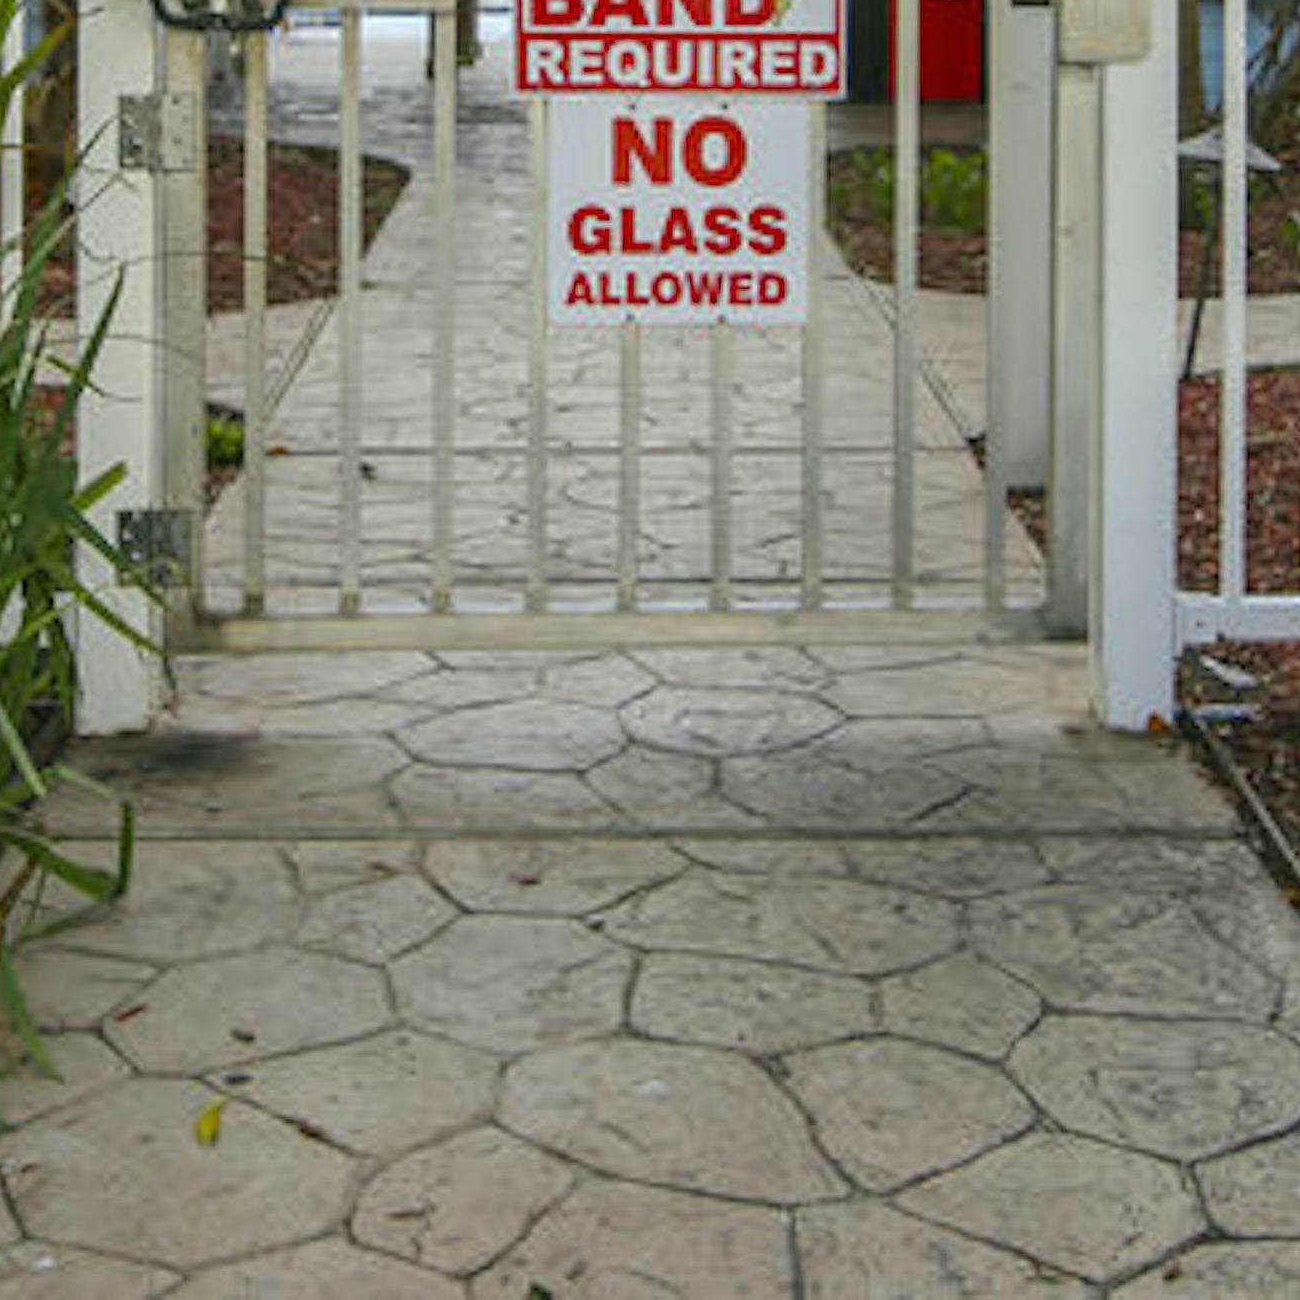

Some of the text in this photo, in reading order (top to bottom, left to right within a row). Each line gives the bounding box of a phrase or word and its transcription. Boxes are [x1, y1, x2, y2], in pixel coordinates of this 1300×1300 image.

[526, 40, 837, 87] REQUIRED
[612, 116, 747, 188] NO
[568, 204, 787, 256] GLASS
[566, 270, 788, 306] ALLOWED
